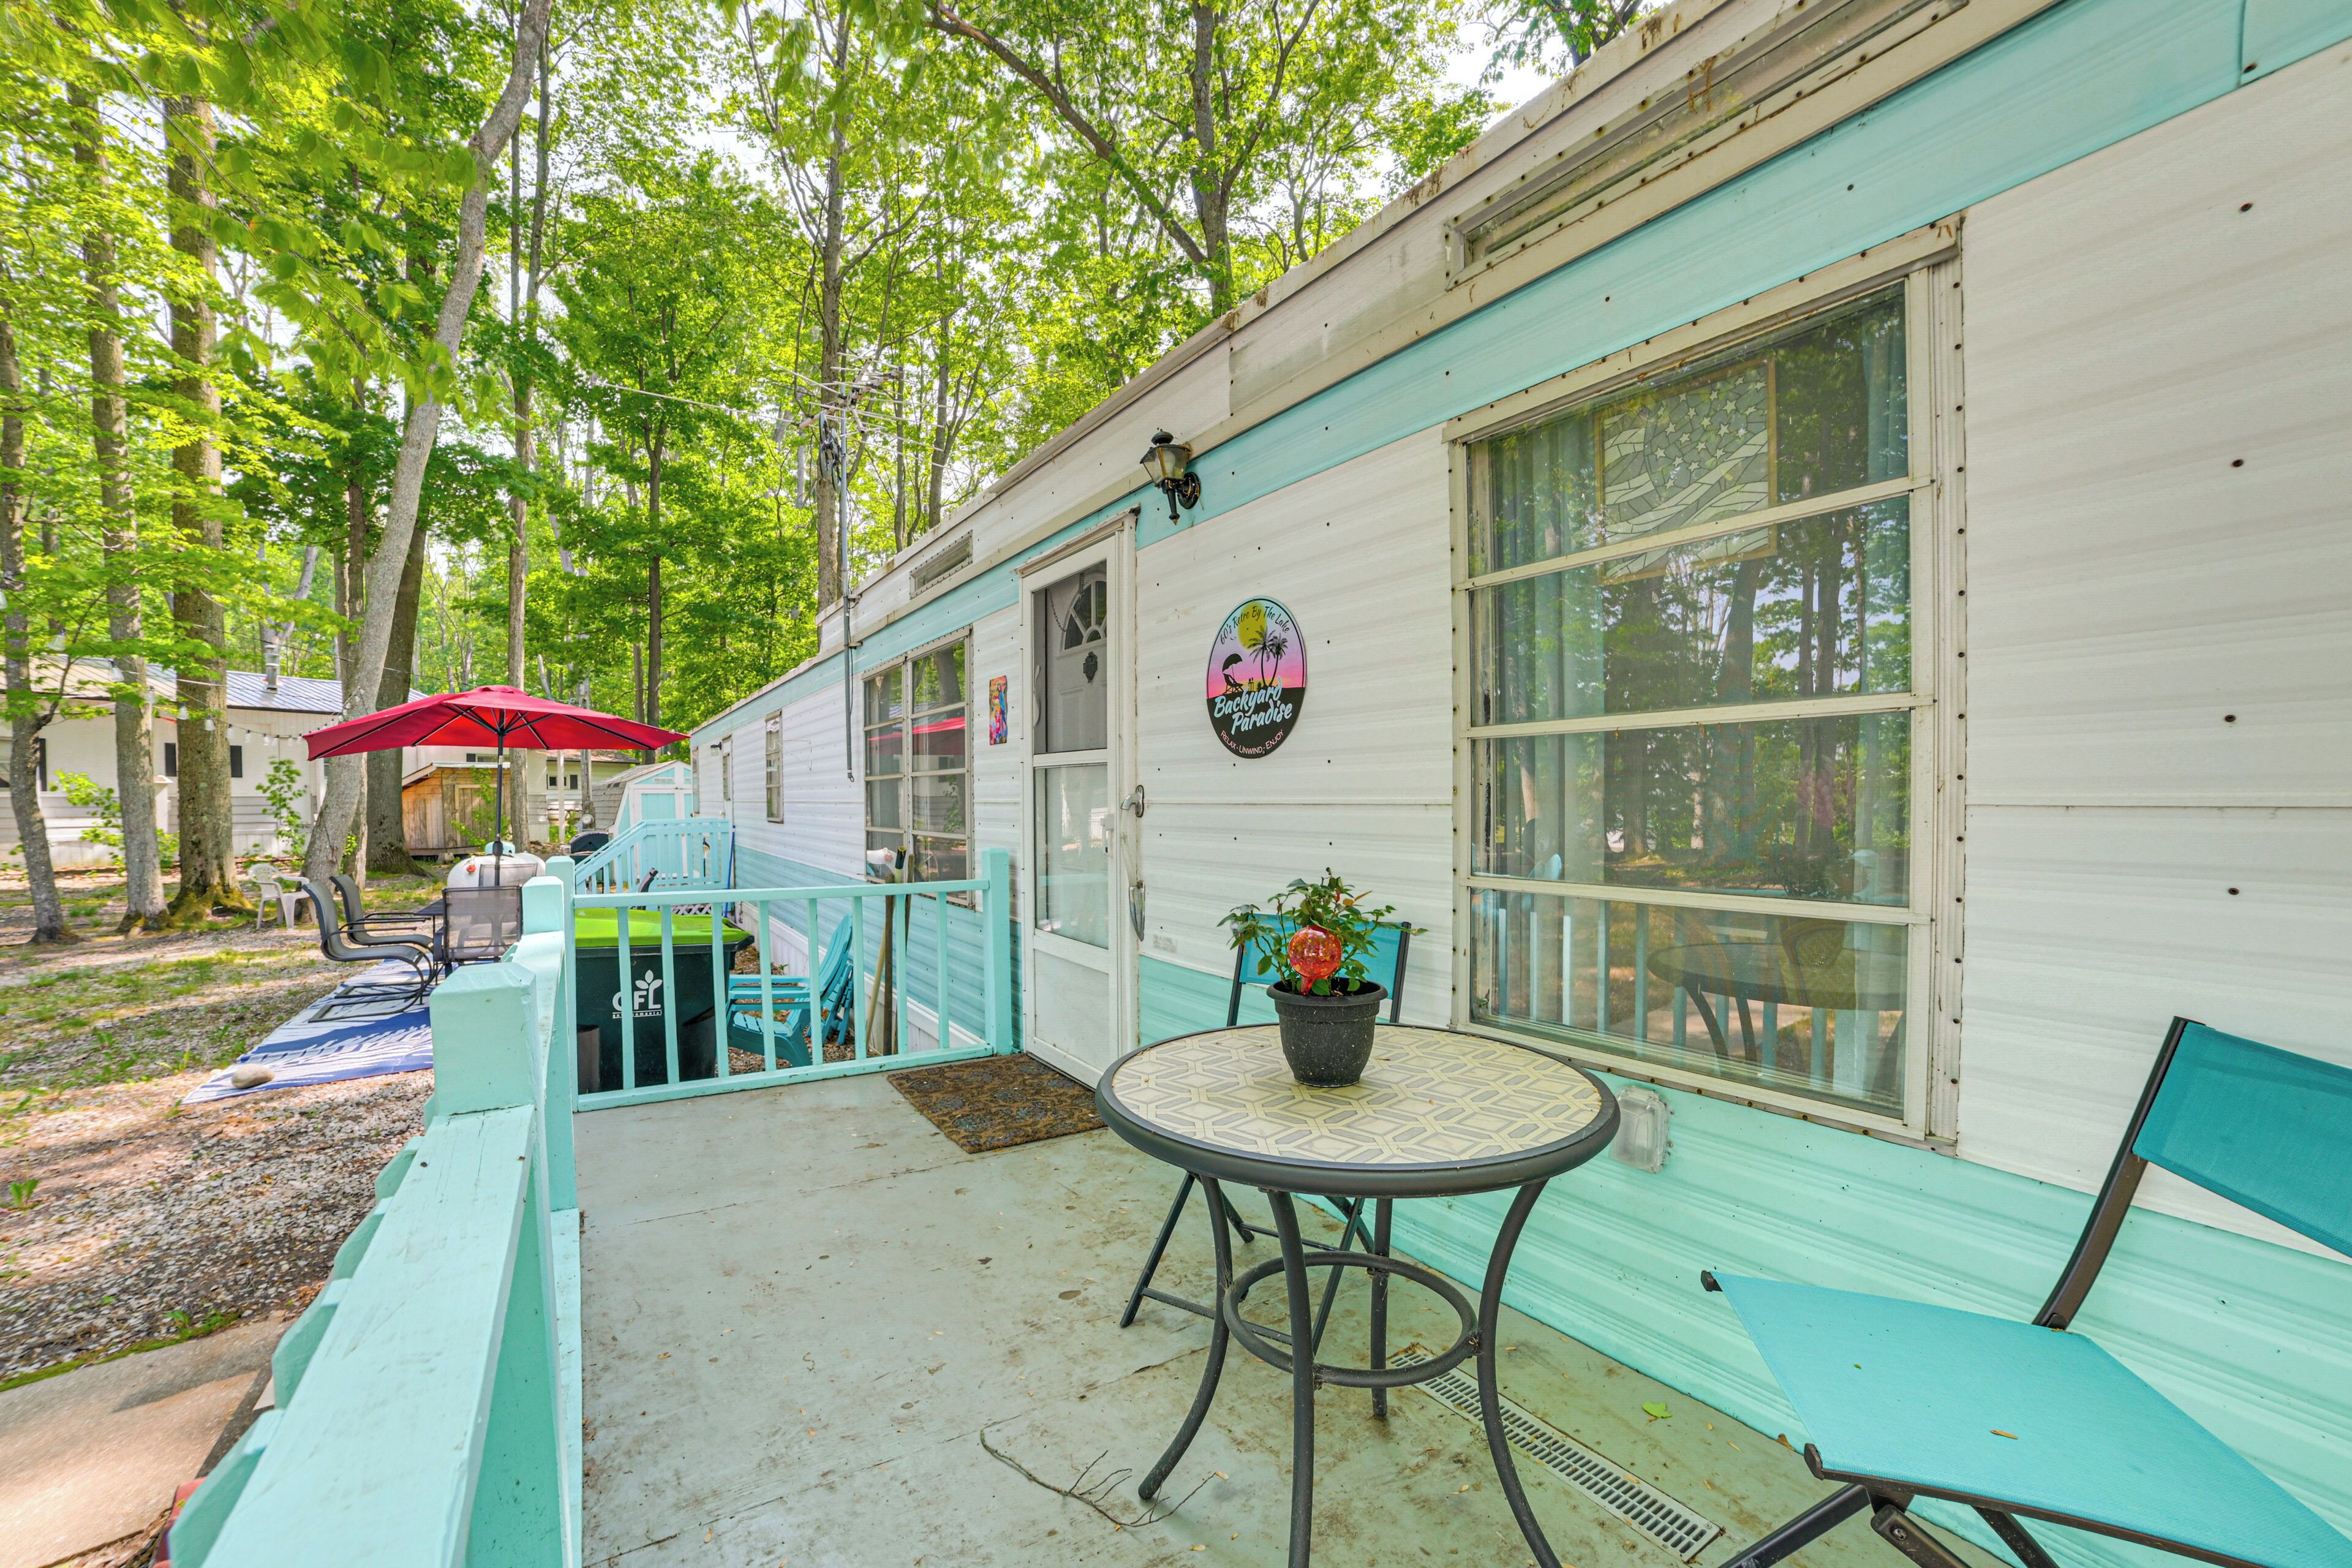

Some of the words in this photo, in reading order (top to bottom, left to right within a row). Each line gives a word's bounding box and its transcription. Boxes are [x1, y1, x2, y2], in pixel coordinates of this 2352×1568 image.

[1220, 624, 1232, 645] 60's
[1232, 611, 1250, 628] Retro
[1251, 605, 1262, 621] By
[1264, 606, 1275, 620] The
[1275, 613, 1290, 633] Lake
[1213, 676, 1283, 718] Backyard
[1231, 698, 1292, 735] Paradise
[1221, 730, 1237, 749] RELAX
[1238, 745, 1262, 755] UNWIND
[1265, 729, 1284, 750] ENJOY
